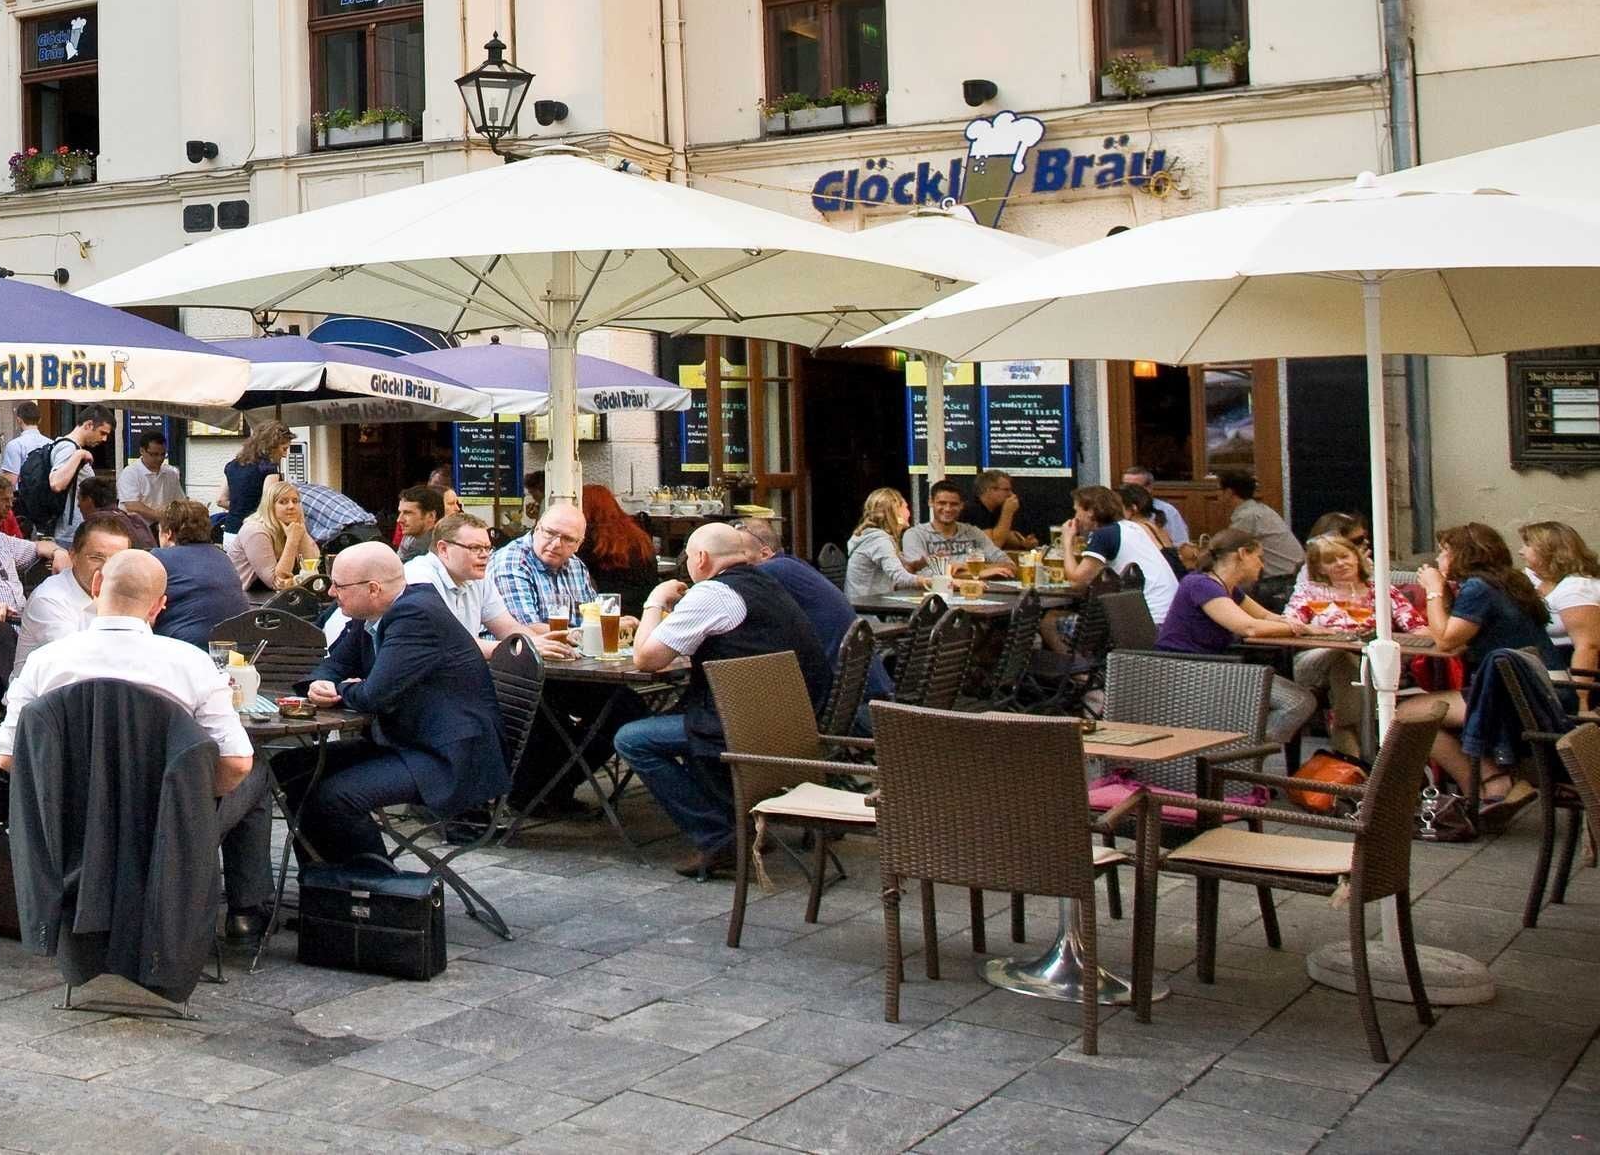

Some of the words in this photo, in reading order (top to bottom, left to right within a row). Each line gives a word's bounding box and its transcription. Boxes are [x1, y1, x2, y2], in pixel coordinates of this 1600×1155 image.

[811, 157, 962, 212] Glöckl
[1032, 134, 1166, 193] Bräu
[40, 349, 106, 390] Bräu
[370, 372, 403, 395] Glöckl
[404, 378, 432, 401] Bräu
[593, 391, 621, 409] Glöckl
[621, 389, 643, 408] Bräu
